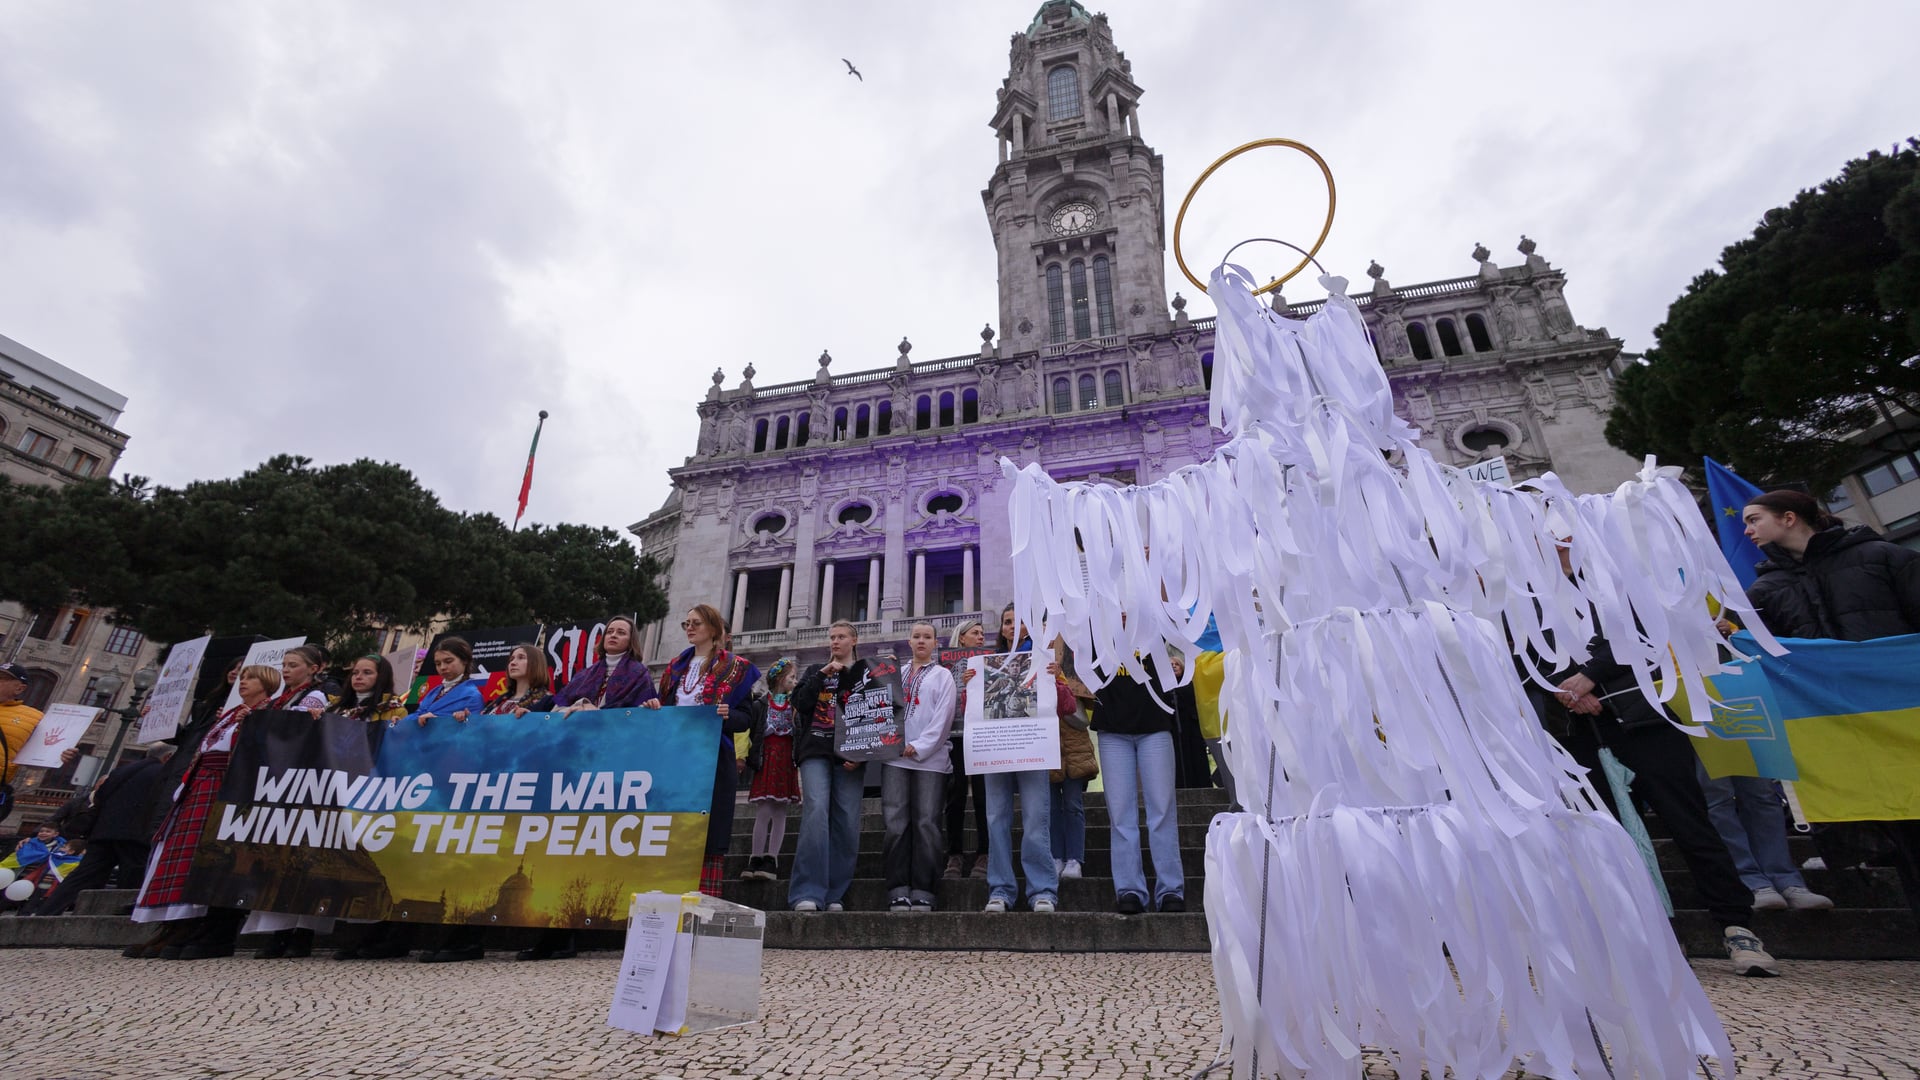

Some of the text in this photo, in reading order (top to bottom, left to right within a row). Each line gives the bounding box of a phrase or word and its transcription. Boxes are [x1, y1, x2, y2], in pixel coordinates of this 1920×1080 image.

[1467, 459, 1505, 481] WE
[255, 649, 285, 664] UKRAIN
[548, 623, 606, 682] STO
[864, 708, 894, 718] THEATER
[254, 766, 653, 811] WINNING THE WAR
[217, 804, 673, 857] WINNING THE PEACE
